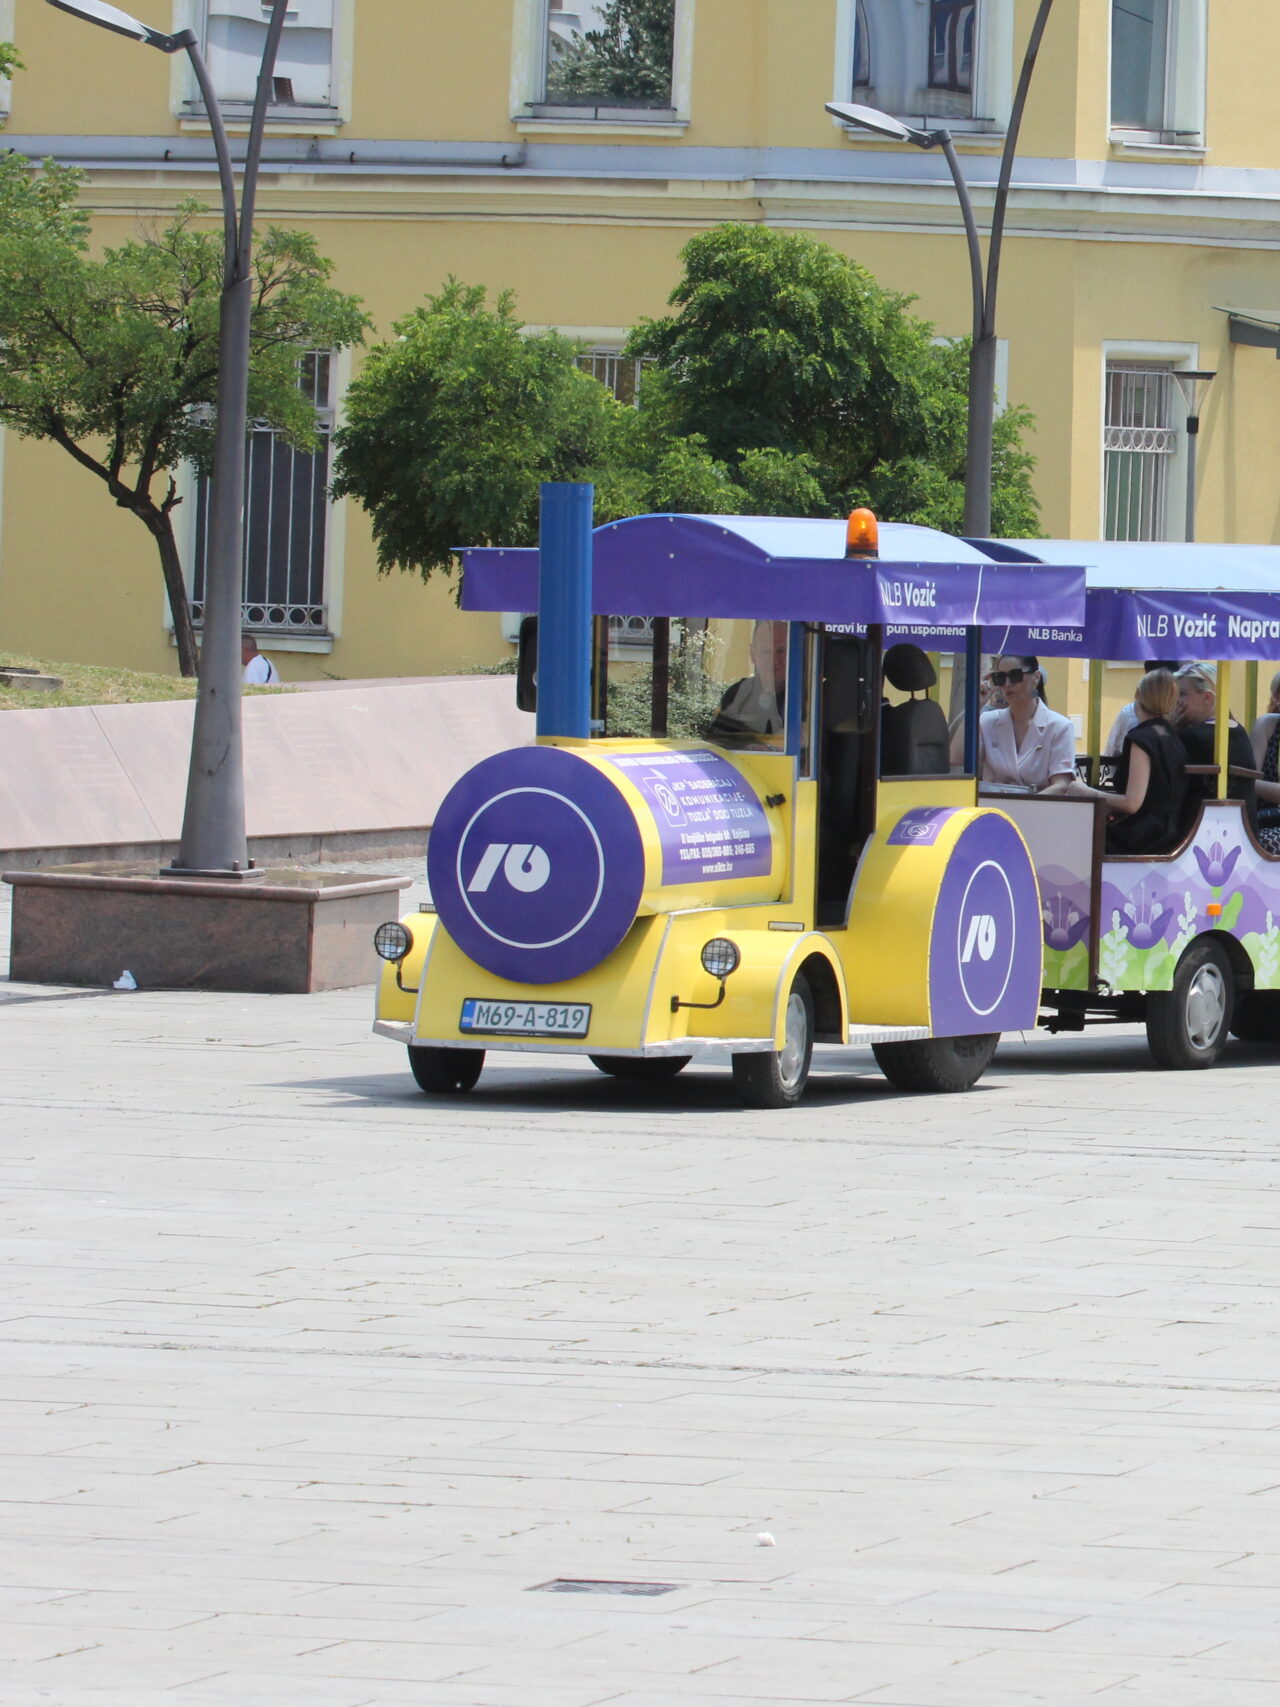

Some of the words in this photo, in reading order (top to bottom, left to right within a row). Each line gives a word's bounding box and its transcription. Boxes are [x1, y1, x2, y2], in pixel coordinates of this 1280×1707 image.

[880, 582, 902, 607] NLB
[903, 580, 936, 608] Vozić
[886, 624, 909, 636] pun
[911, 625, 967, 637] uspomena
[1028, 628, 1050, 640] NLB
[1051, 629, 1083, 642] Banka
[1137, 614, 1168, 638] NLB
[1173, 613, 1217, 638] Vozić
[730, 808, 754, 819] TUZLA
[475, 1005, 585, 1029] M69-A-819
